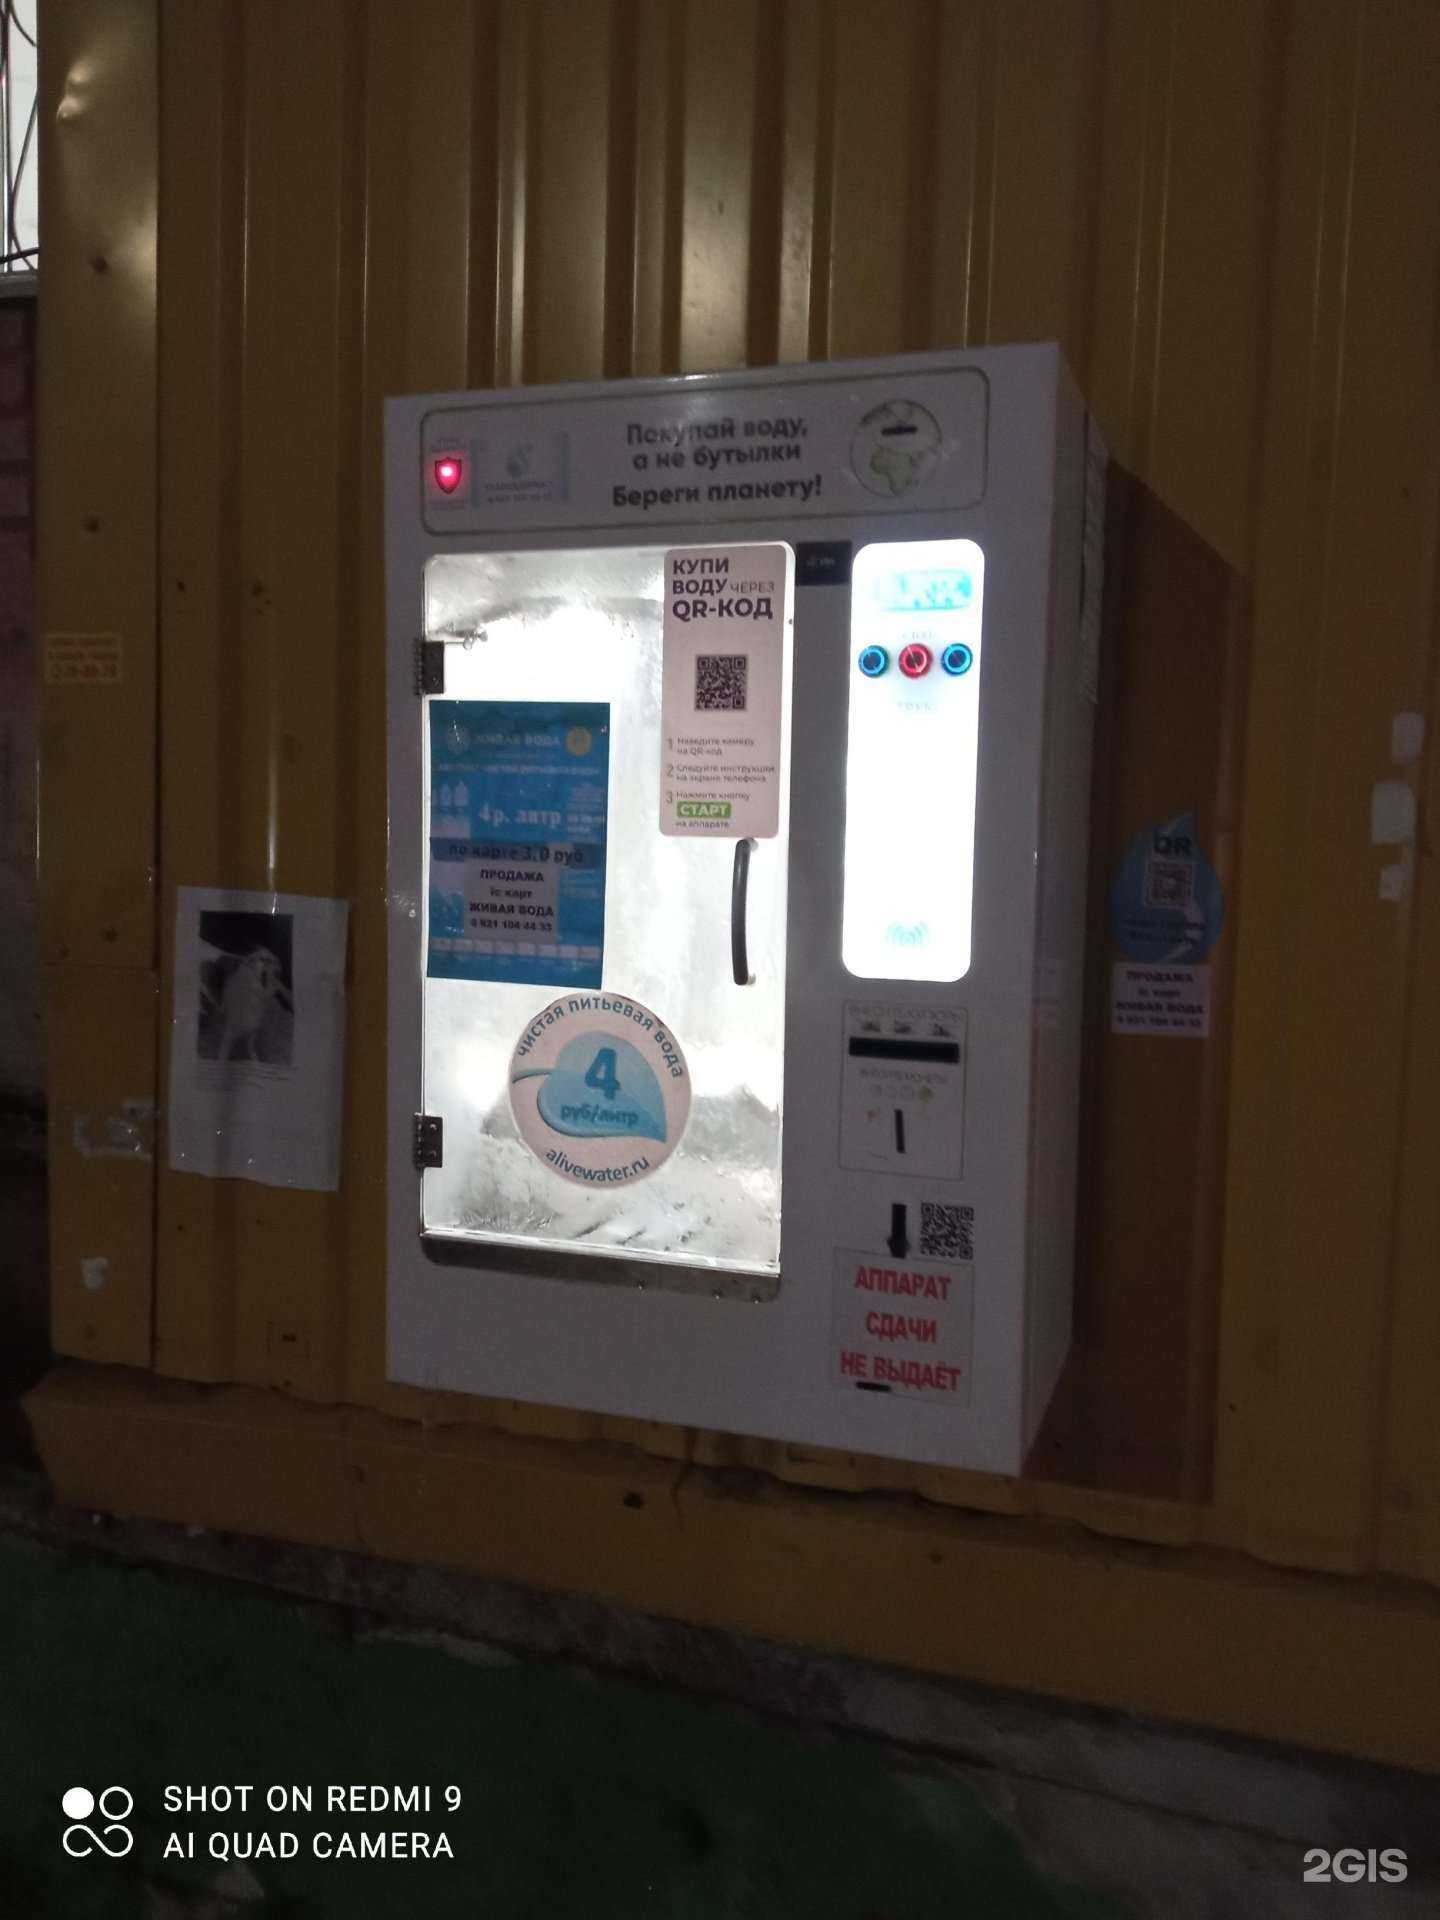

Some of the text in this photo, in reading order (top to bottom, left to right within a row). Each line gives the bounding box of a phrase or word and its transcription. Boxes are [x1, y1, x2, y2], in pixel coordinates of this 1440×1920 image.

[627, 417, 808, 446] Покупай воду,
[633, 444, 801, 470] а не бутылки
[612, 474, 823, 510] Береги планету!
[673, 558, 729, 575] КУПИ
[673, 579, 775, 597] ВОДУ ЧЕРЕЗ
[672, 598, 773, 622] QR-КОД
[680, 804, 727, 816] СТАРТ
[481, 869, 544, 881] ПРОДАЖА
[469, 902, 554, 917] ЖИВАЯ ВОДА
[518, 997, 683, 1079] чистая питьевая вода
[585, 1047, 620, 1100] 4
[561, 1103, 639, 1126] руб/литр
[545, 1149, 650, 1182] alivewater.ru
[854, 1265, 952, 1301] АППАРАТ
[866, 1311, 937, 1344] СДАЧИ
[840, 1351, 867, 1377] НЕ
